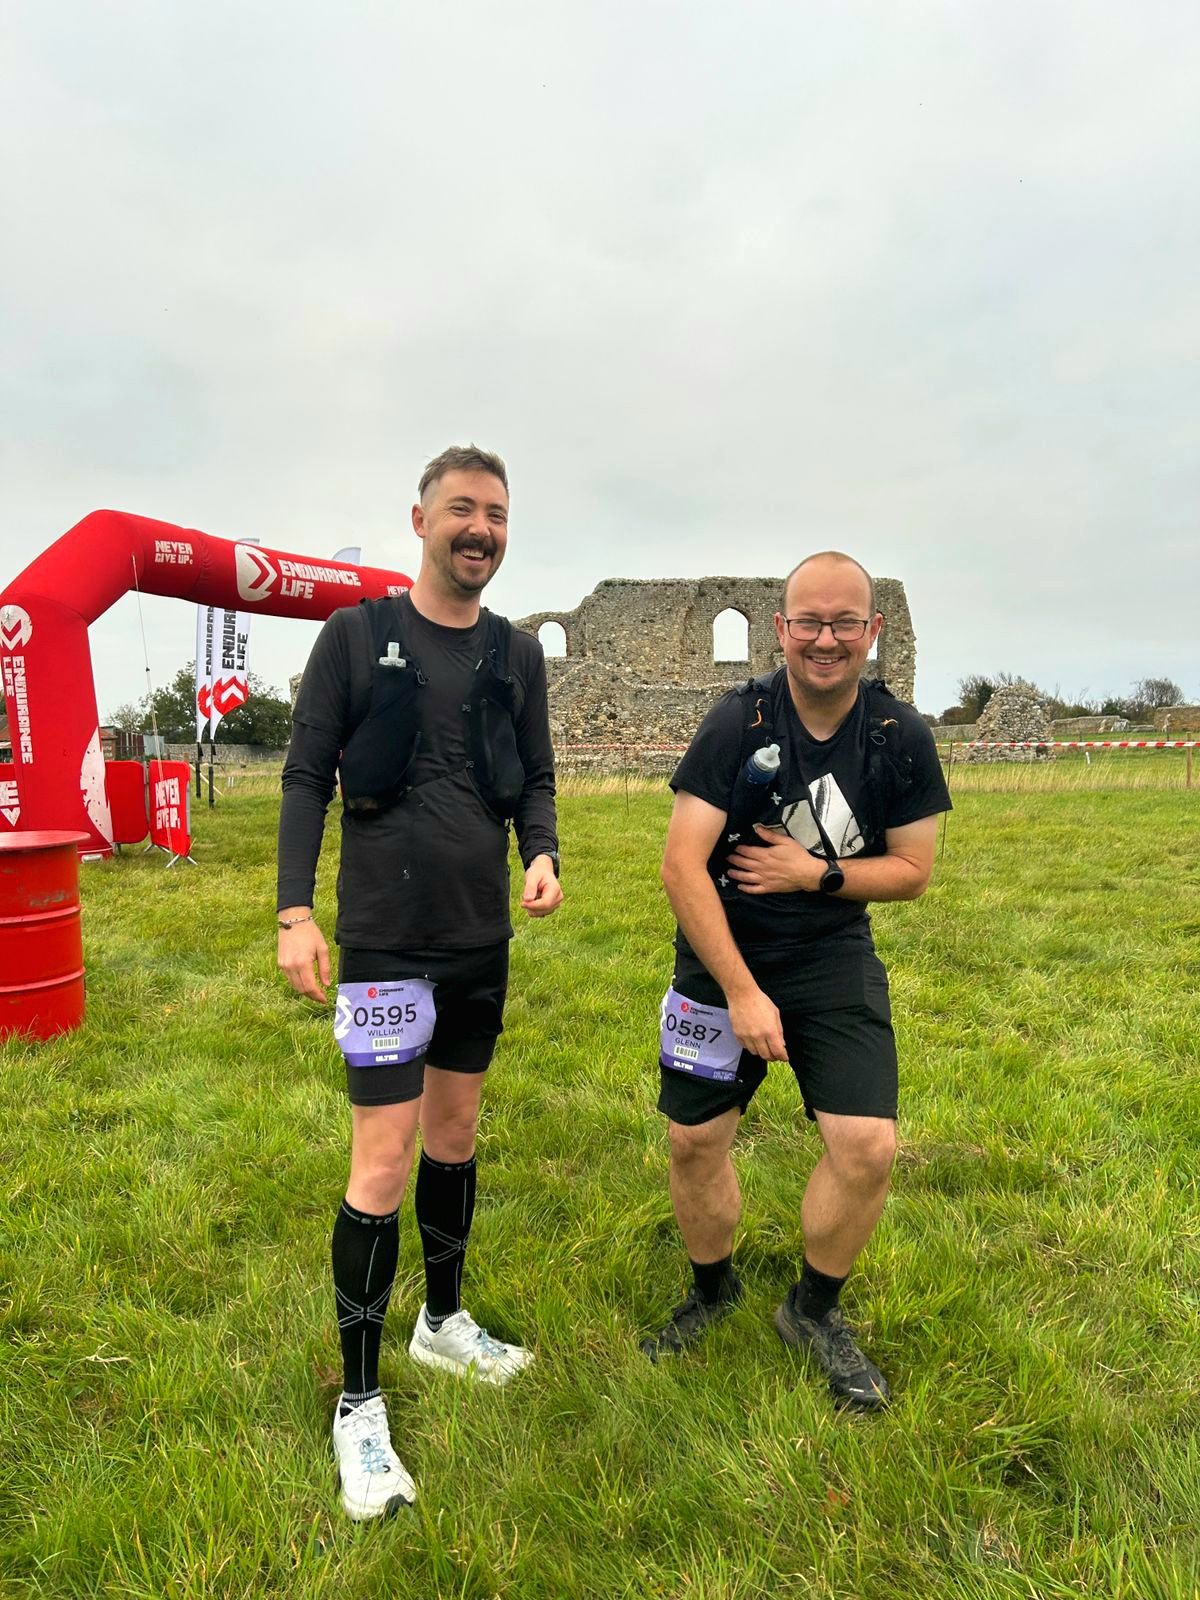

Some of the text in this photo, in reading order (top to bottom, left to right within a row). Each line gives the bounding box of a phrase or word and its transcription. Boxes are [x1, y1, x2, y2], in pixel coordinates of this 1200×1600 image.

[155, 540, 193, 555] NEVER
[155, 553, 176, 564] GIVE
[278, 559, 361, 586] ENDURANCE
[280, 578, 315, 599] LIFE
[222, 609, 237, 670] ENDUR
[236, 633, 249, 671] LIFE
[3, 656, 15, 697] LIFE
[12, 655, 34, 764] ENDURANCE
[155, 777, 180, 809] NEVER
[353, 1003, 417, 1028] 0595
[666, 1013, 722, 1044] 0587
[367, 1027, 404, 1037] WILLIAM
[675, 1037, 701, 1049] GLENN
